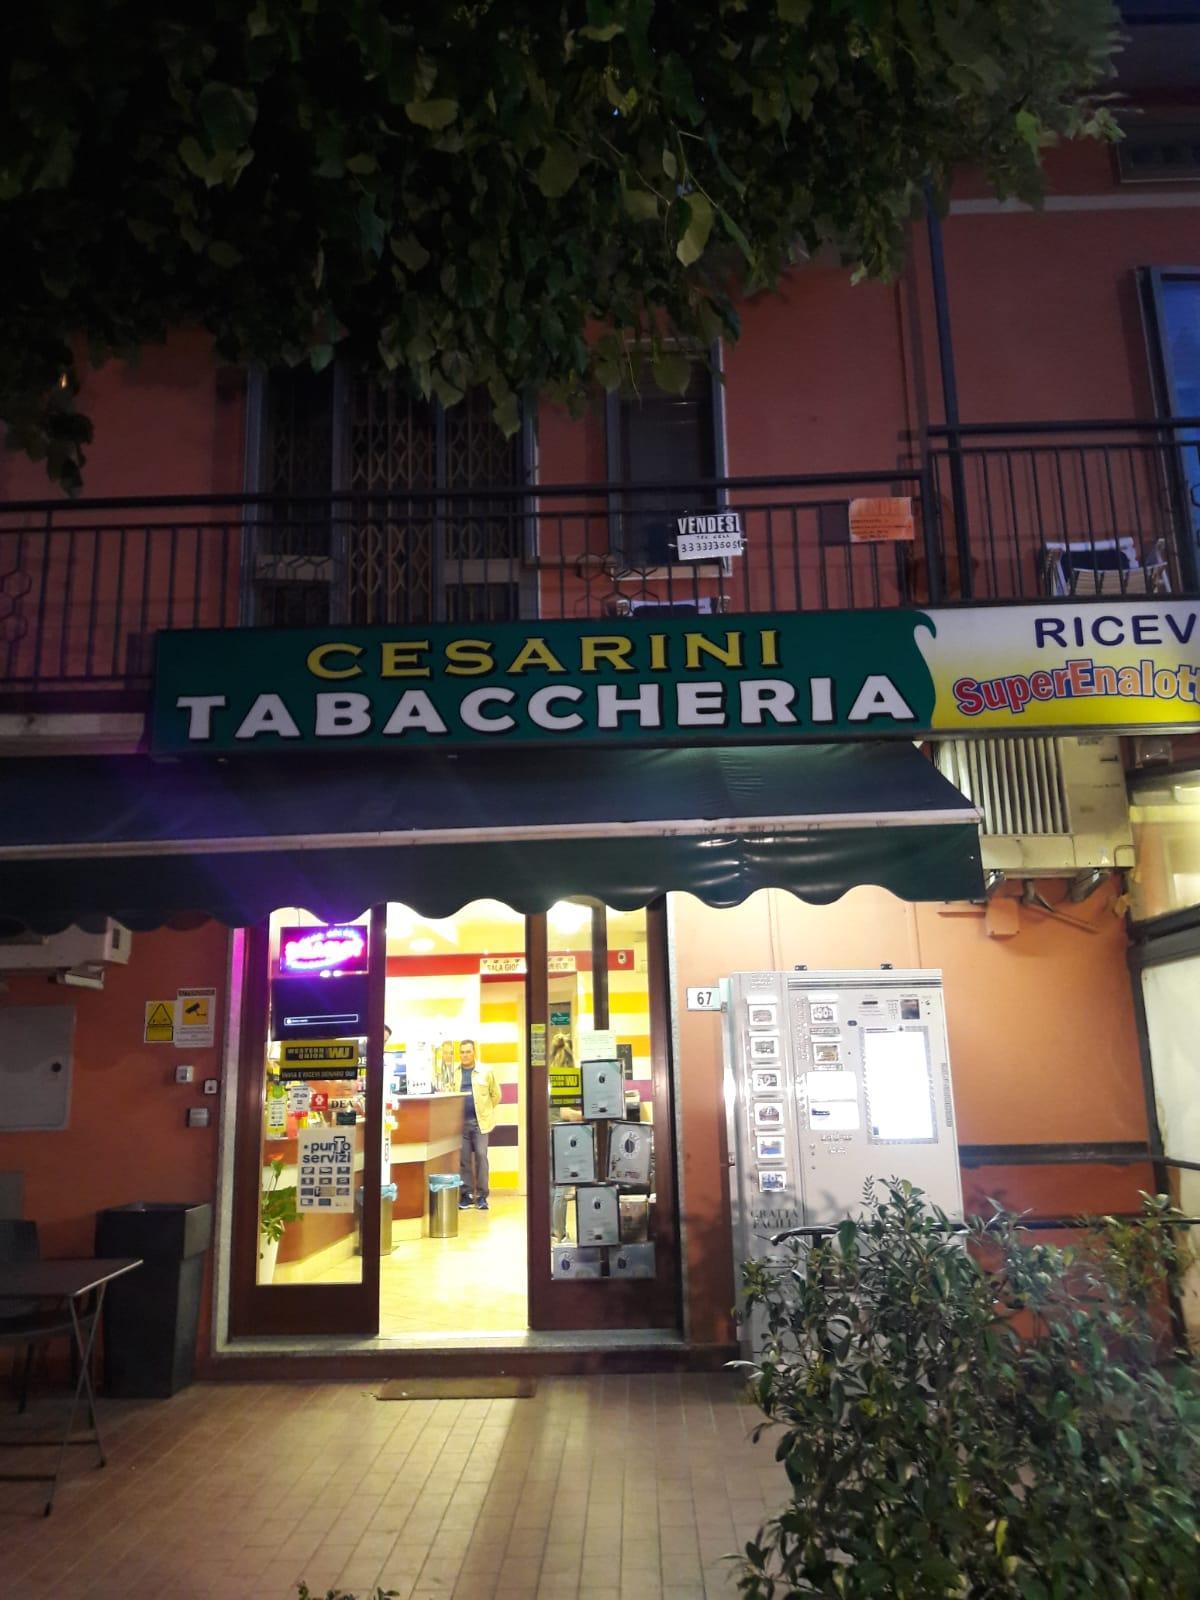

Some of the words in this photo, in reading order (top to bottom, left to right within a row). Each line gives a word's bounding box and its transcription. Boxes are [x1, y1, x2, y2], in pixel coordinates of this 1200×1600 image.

[677, 516, 740, 535] VENDESI
[1034, 612, 1197, 649] RICEV
[306, 629, 781, 680] CESARINI
[176, 675, 916, 741] TABACCHERIA
[697, 991, 712, 1006] 67
[328, 1047, 350, 1058] WU
[302, 1152, 351, 1163] servizi
